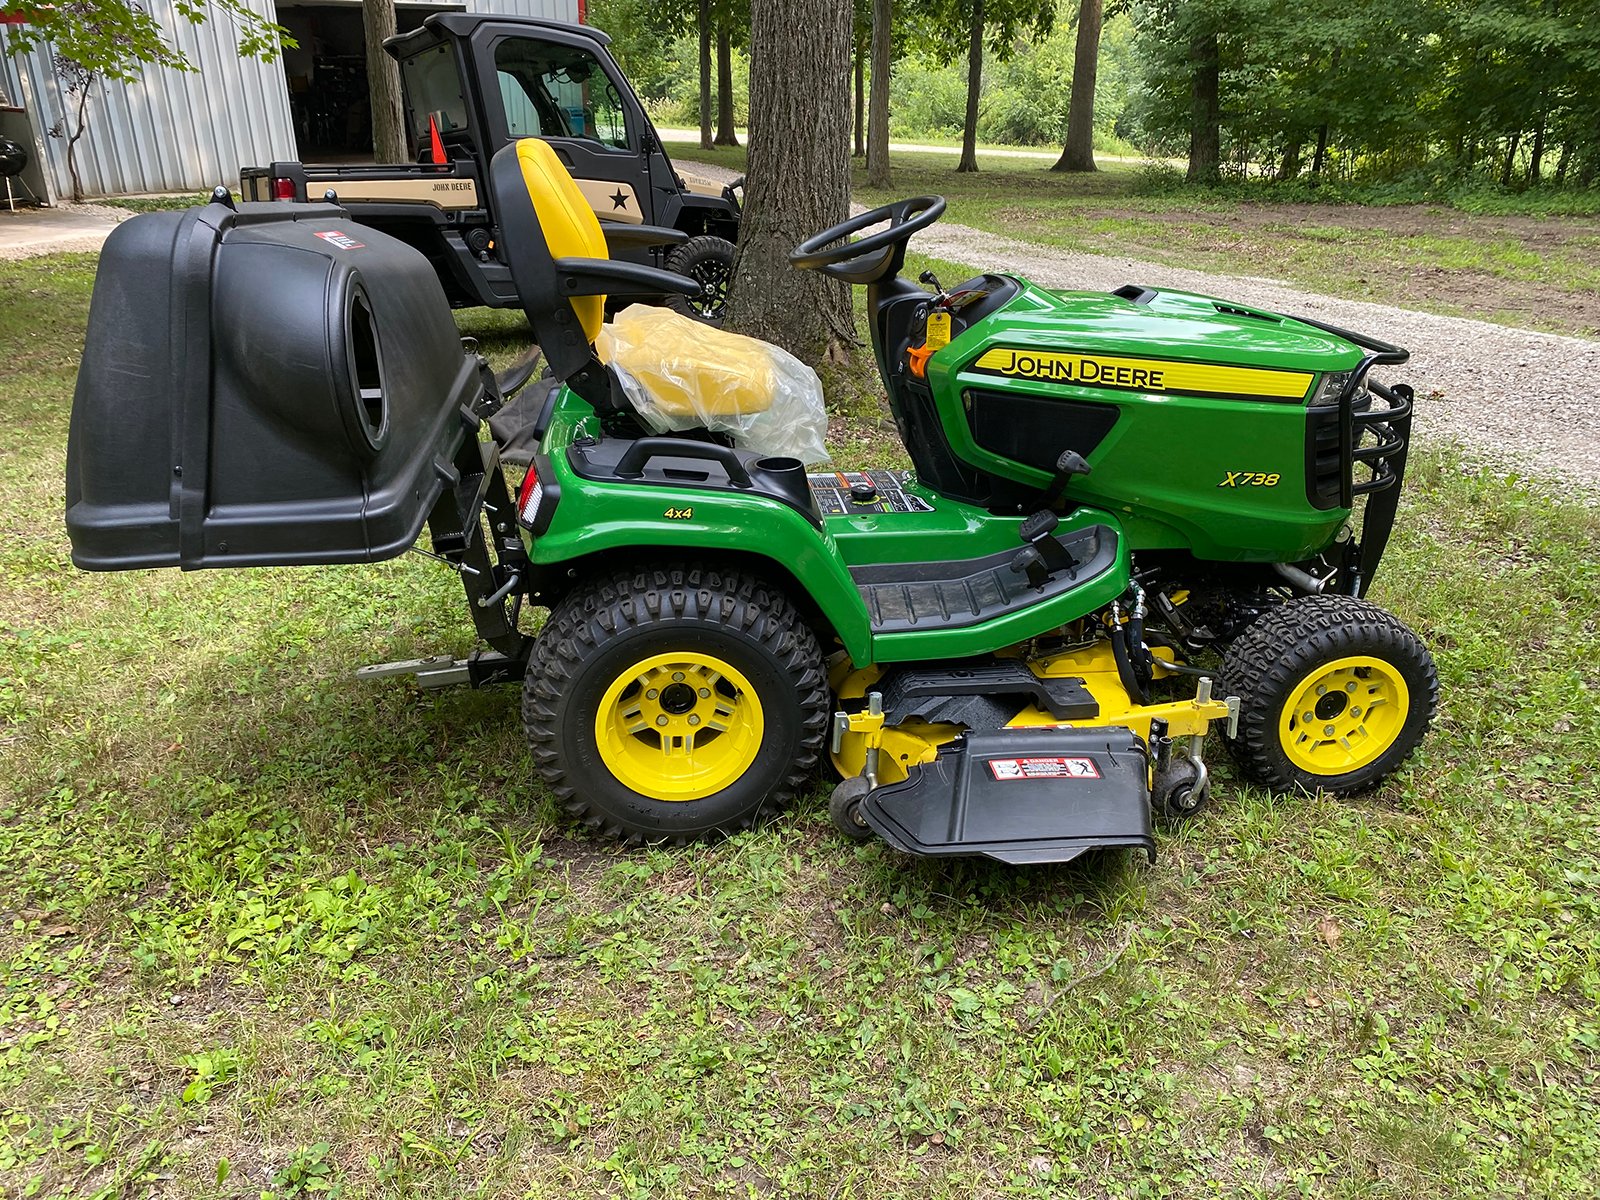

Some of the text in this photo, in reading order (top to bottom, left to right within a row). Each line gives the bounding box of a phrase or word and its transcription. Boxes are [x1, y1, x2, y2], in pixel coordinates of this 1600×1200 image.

[451, 182, 472, 191] DEERE
[1001, 352, 1165, 389] JOHN DEERE
[1218, 471, 1281, 487] X738
[663, 507, 693, 519] 4x4
